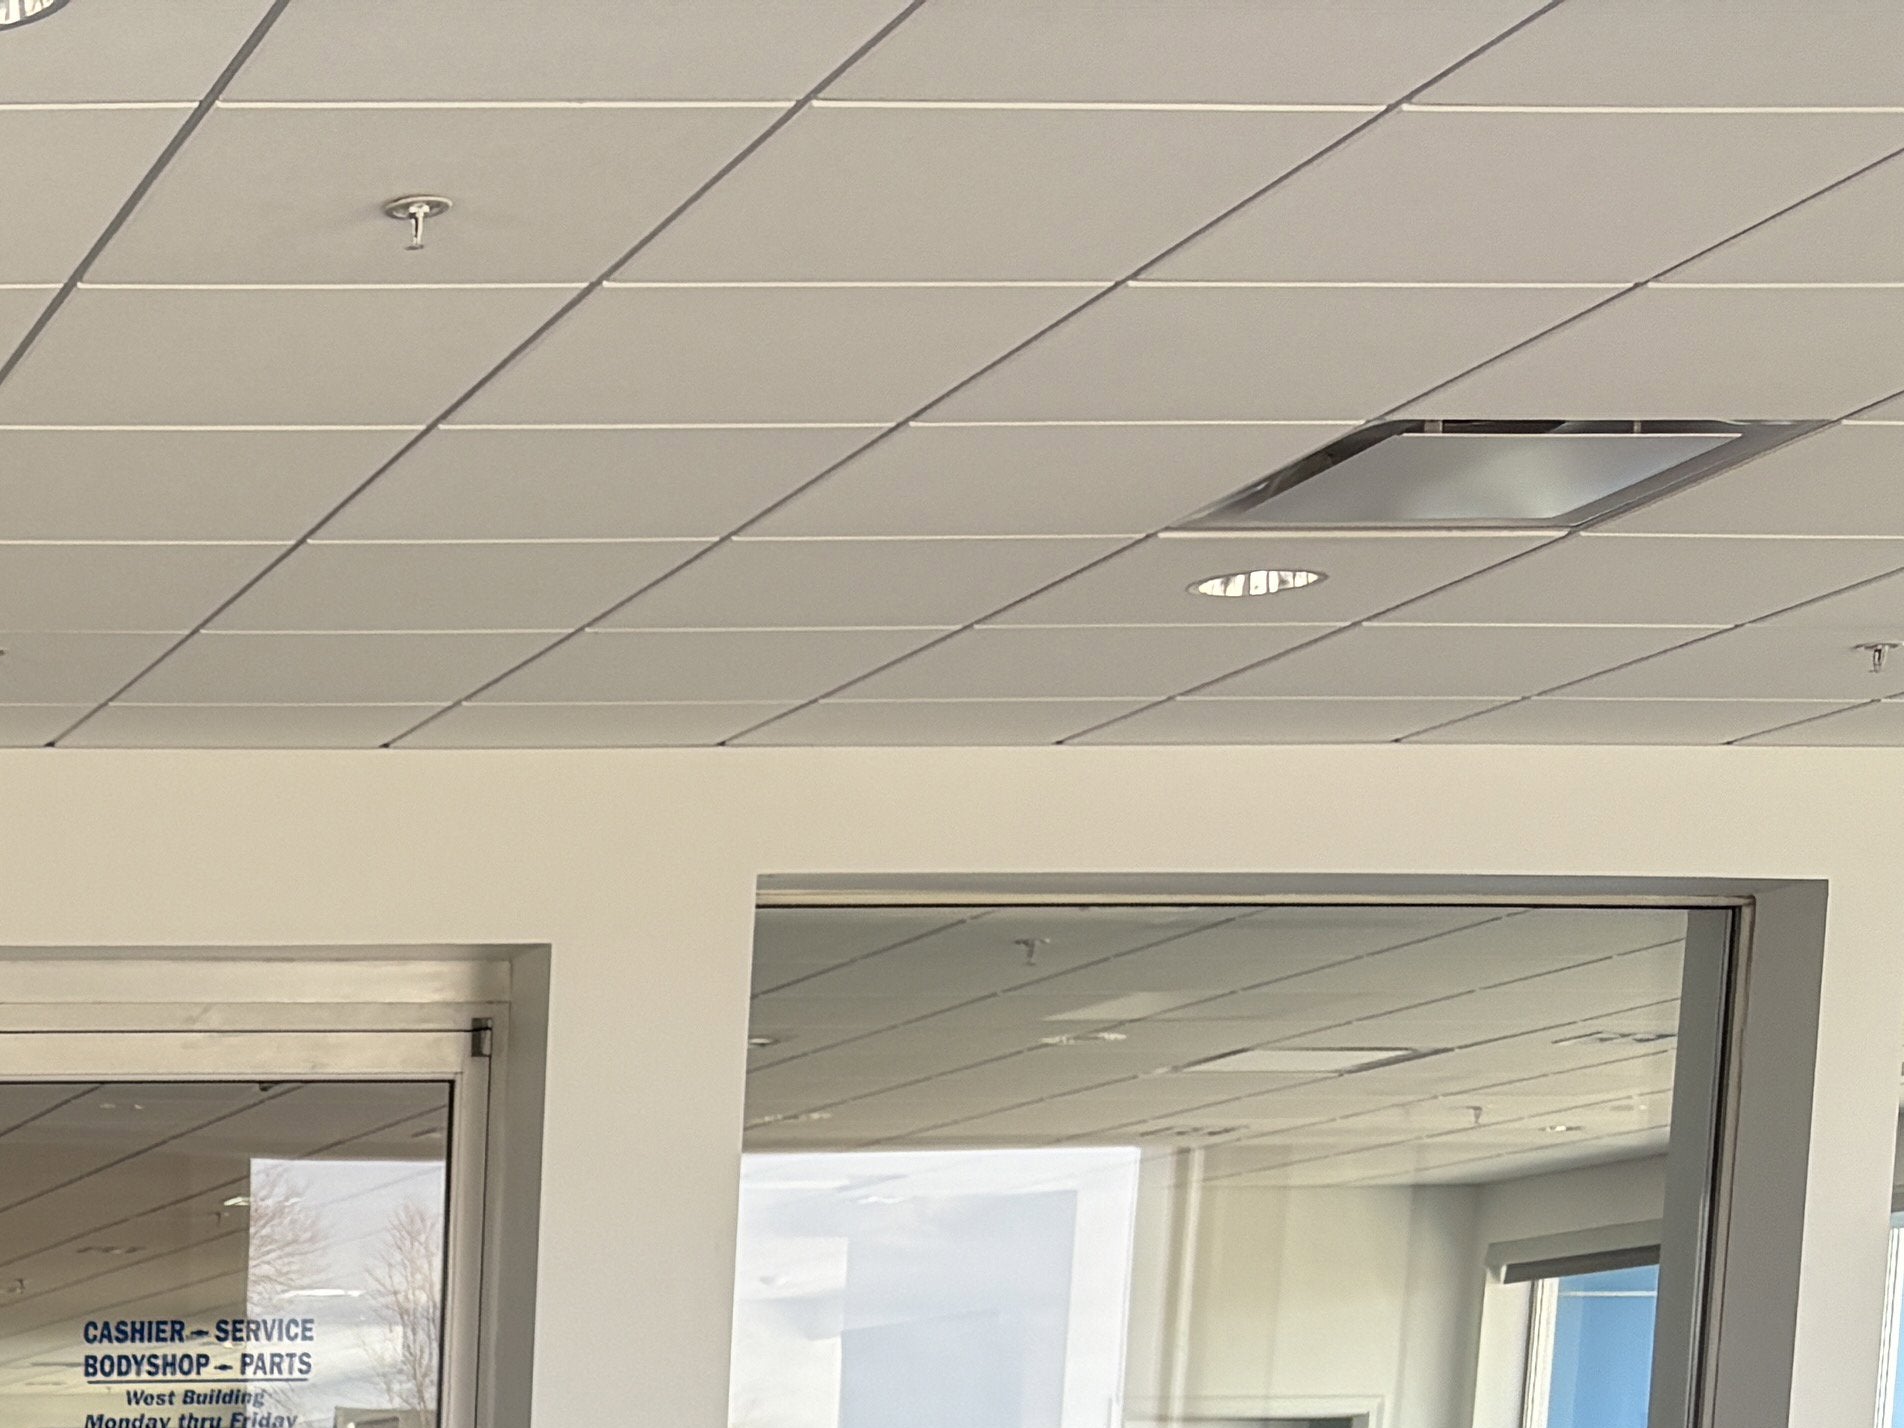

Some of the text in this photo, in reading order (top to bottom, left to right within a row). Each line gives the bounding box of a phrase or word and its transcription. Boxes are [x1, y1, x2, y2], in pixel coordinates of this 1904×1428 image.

[83, 1318, 315, 1344] CASHIER SERVICE
[83, 1352, 312, 1377] BODYSHOP PARTS
[126, 1389, 265, 1409] West Building
